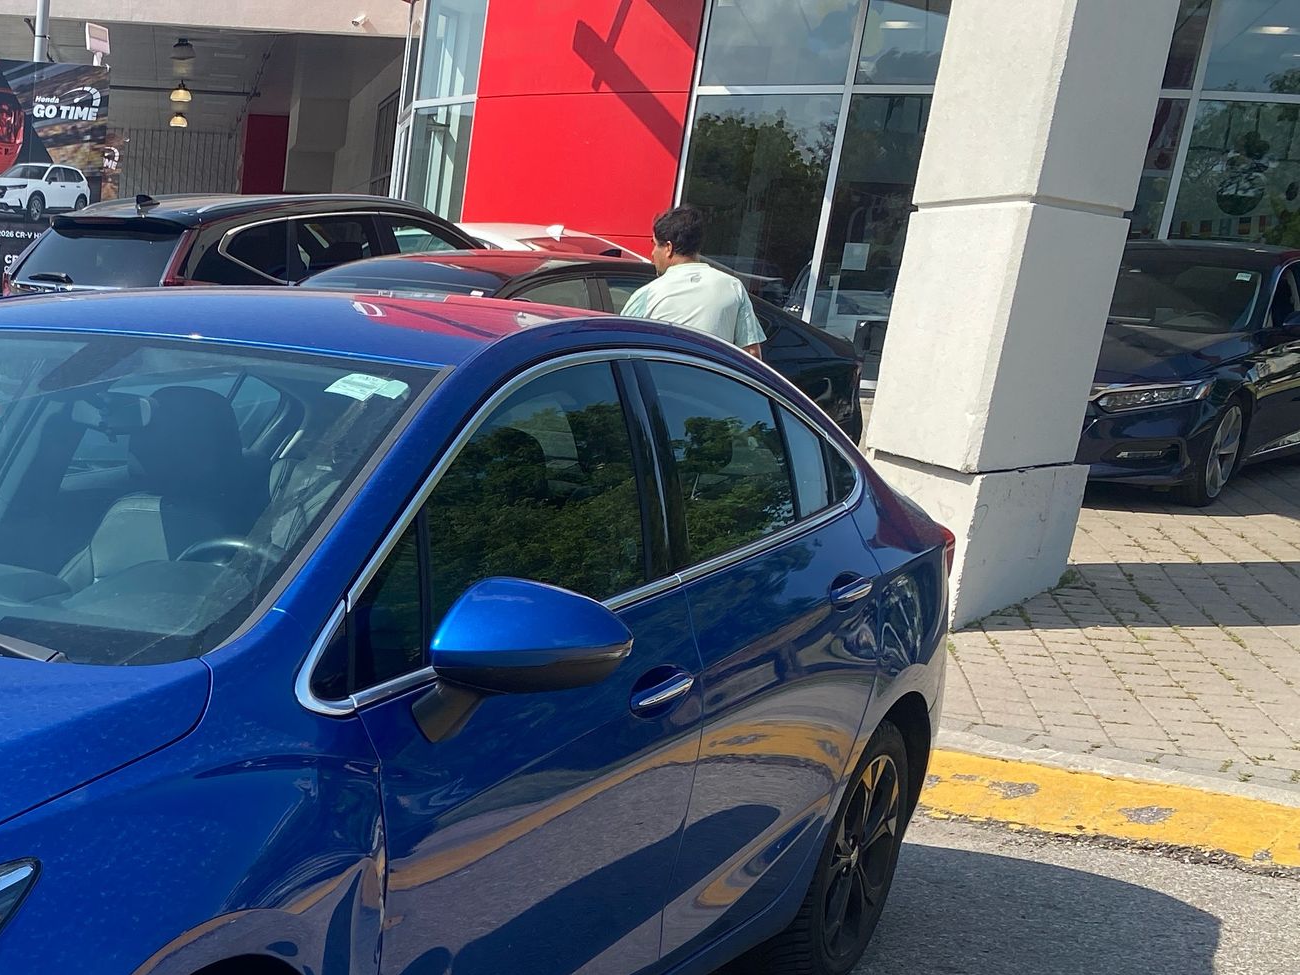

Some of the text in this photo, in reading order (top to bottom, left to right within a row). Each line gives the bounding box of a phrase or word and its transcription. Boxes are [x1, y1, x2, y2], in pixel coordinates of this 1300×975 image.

[35, 95, 60, 104] Honda
[33, 104, 99, 121] GO TIME
[15, 231, 33, 239] CR-V
